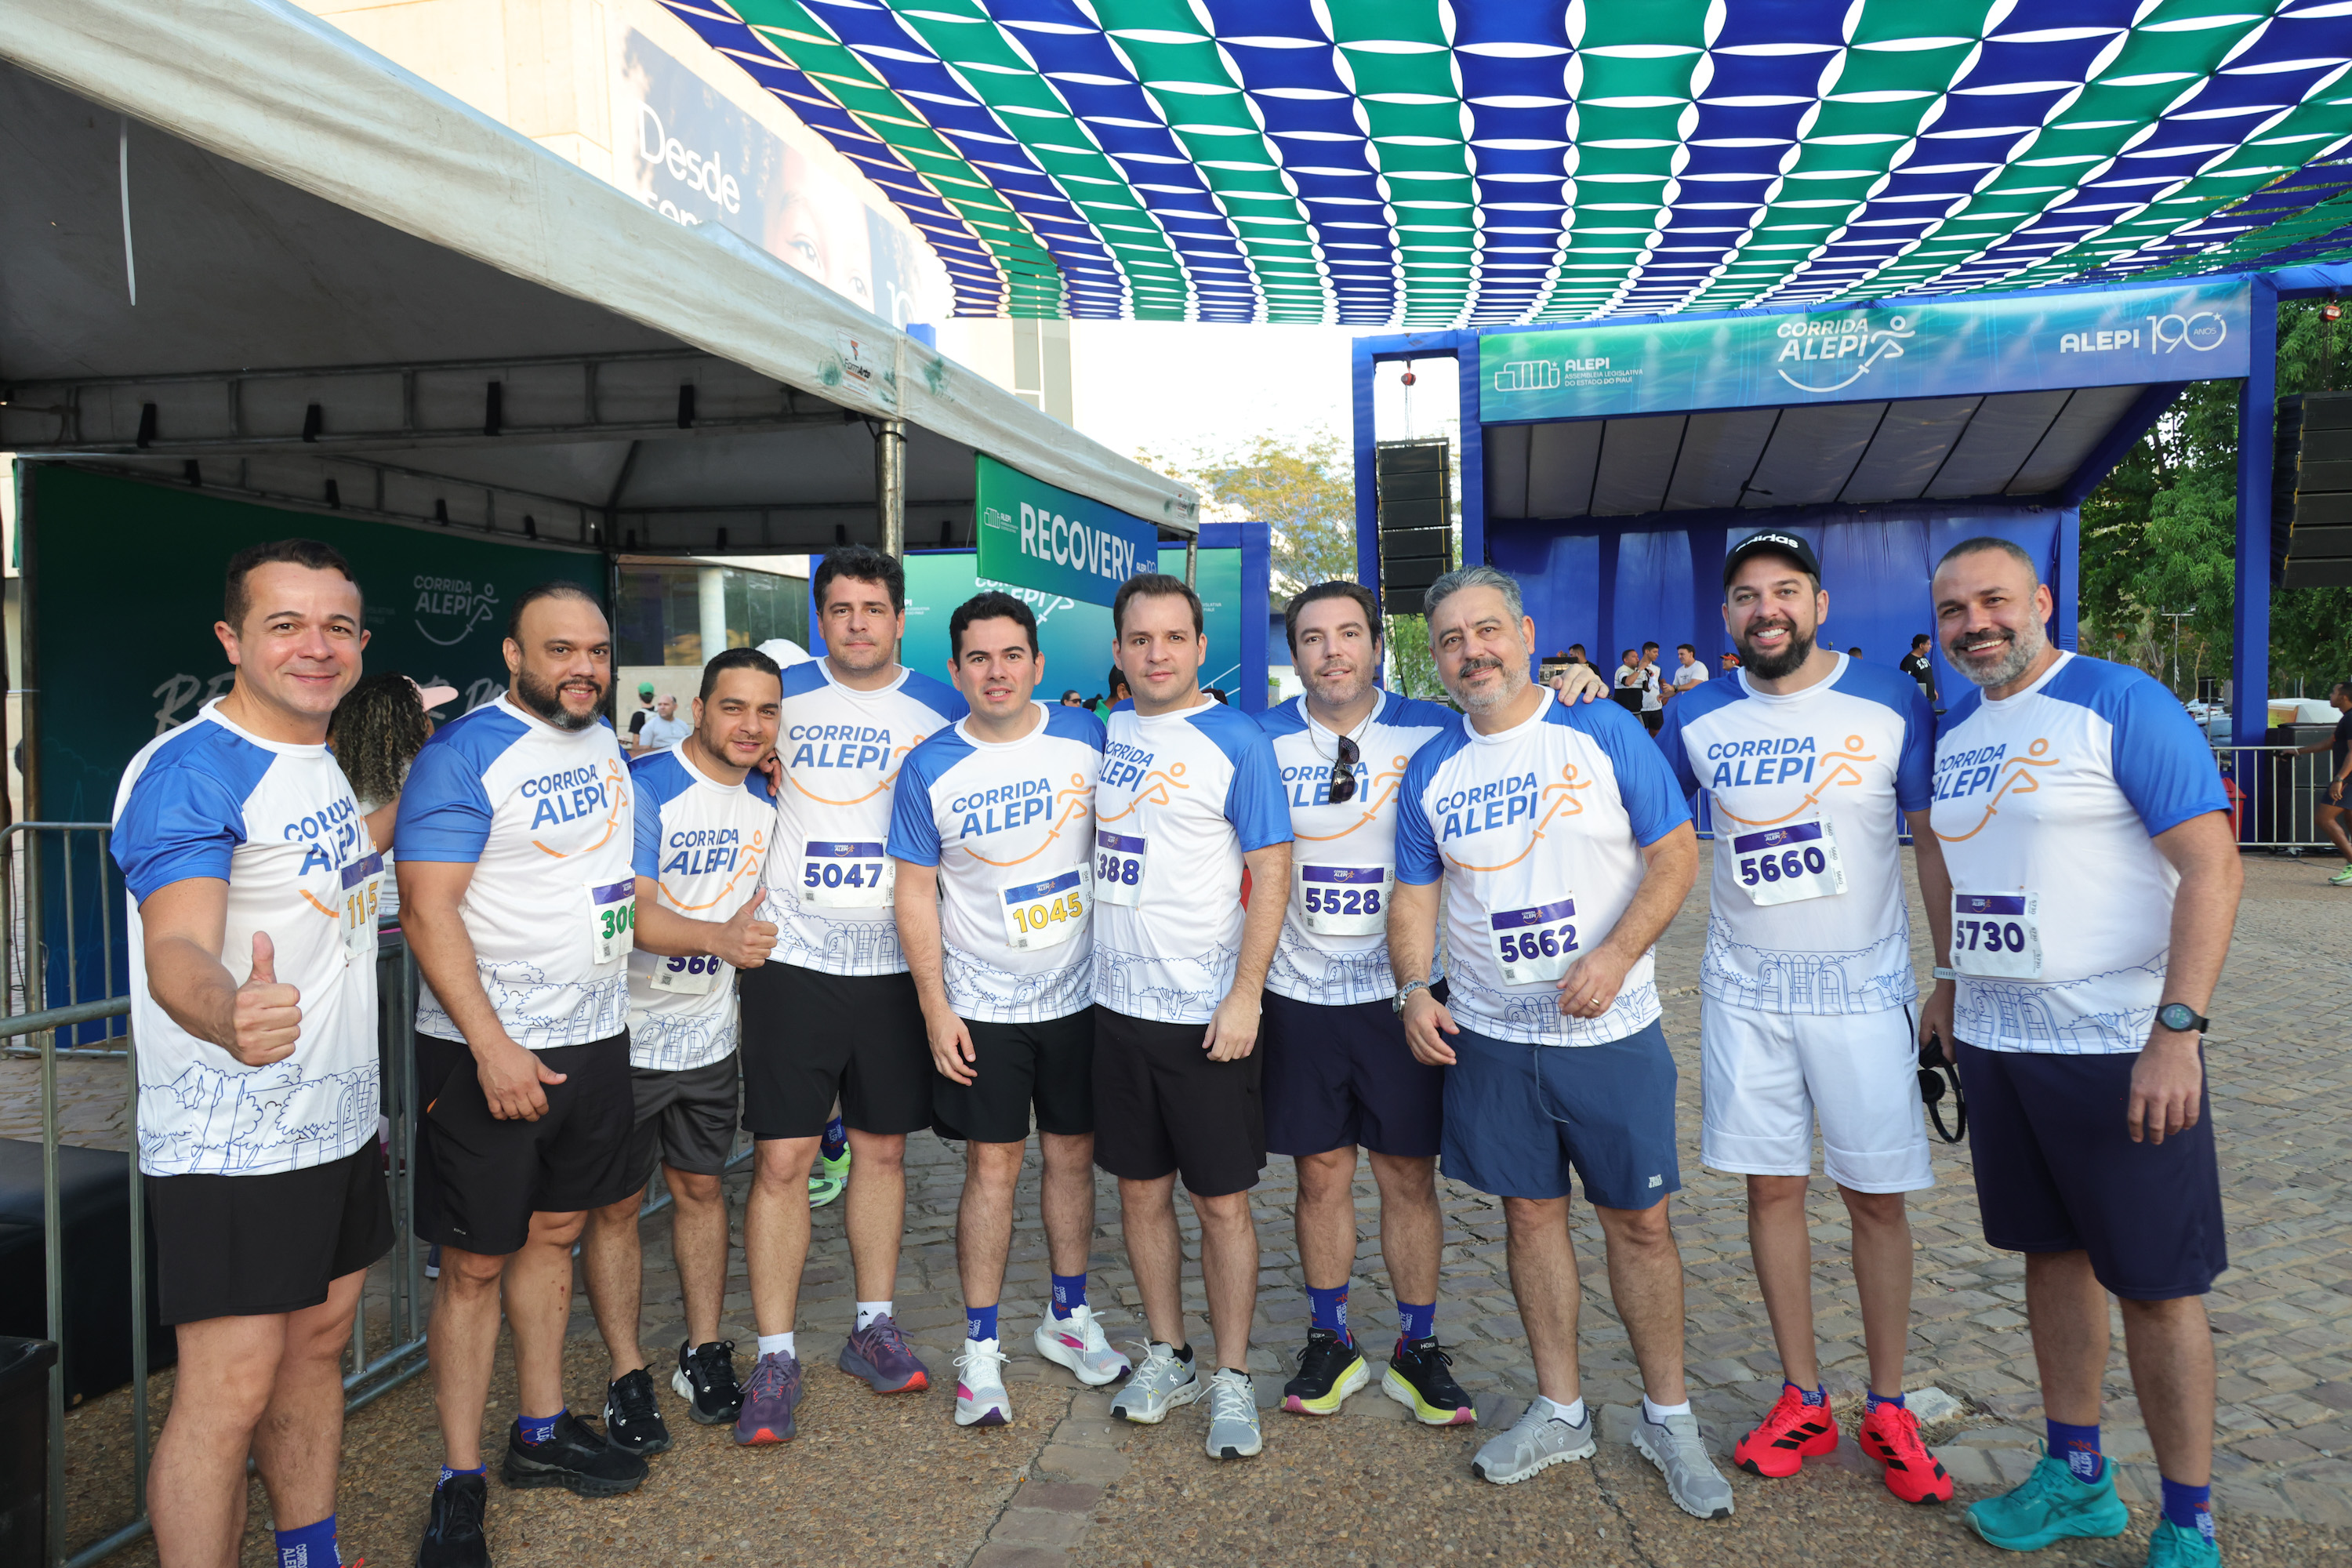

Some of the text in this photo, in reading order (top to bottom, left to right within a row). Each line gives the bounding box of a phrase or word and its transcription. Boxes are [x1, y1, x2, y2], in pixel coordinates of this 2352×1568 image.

[637, 102, 740, 214] Desde
[1777, 318, 1869, 339] CORRIDA
[2060, 312, 2227, 354] ALEPI 190
[2193, 327, 2217, 336] ANOS
[1565, 357, 1610, 372] ALEPI
[1777, 335, 1868, 362] ALEPI
[1565, 368, 1643, 380] ASSEMBLEIA LEGISLATIVA
[1021, 502, 1134, 582] RECOVERY
[414, 575, 473, 594] CORRIDA
[415, 591, 472, 616] ALEPI
[789, 725, 891, 744] CORRIDA
[1708, 736, 1816, 760] CORRIDA
[791, 743, 891, 771] ALEPI
[1711, 756, 1816, 789] ALEPI
[521, 764, 598, 798] CORRIDA
[1098, 757, 1146, 792] LEPI
[531, 782, 608, 830] ALEPI
[952, 778, 1051, 814] CORRIDA
[1436, 771, 1537, 815] CORRIDA
[960, 795, 1053, 840] ALEPI
[1442, 791, 1538, 843] ALEPI
[670, 829, 739, 848] CORRIDA
[662, 848, 738, 876] ALEPI
[804, 862, 883, 888] 5047
[1098, 853, 1140, 886] 388
[1740, 847, 1826, 886] 5660
[1013, 892, 1083, 933] 1045
[1305, 887, 1381, 916] 5528
[1500, 924, 1579, 963] 5662
[1956, 920, 2025, 953] 5730
